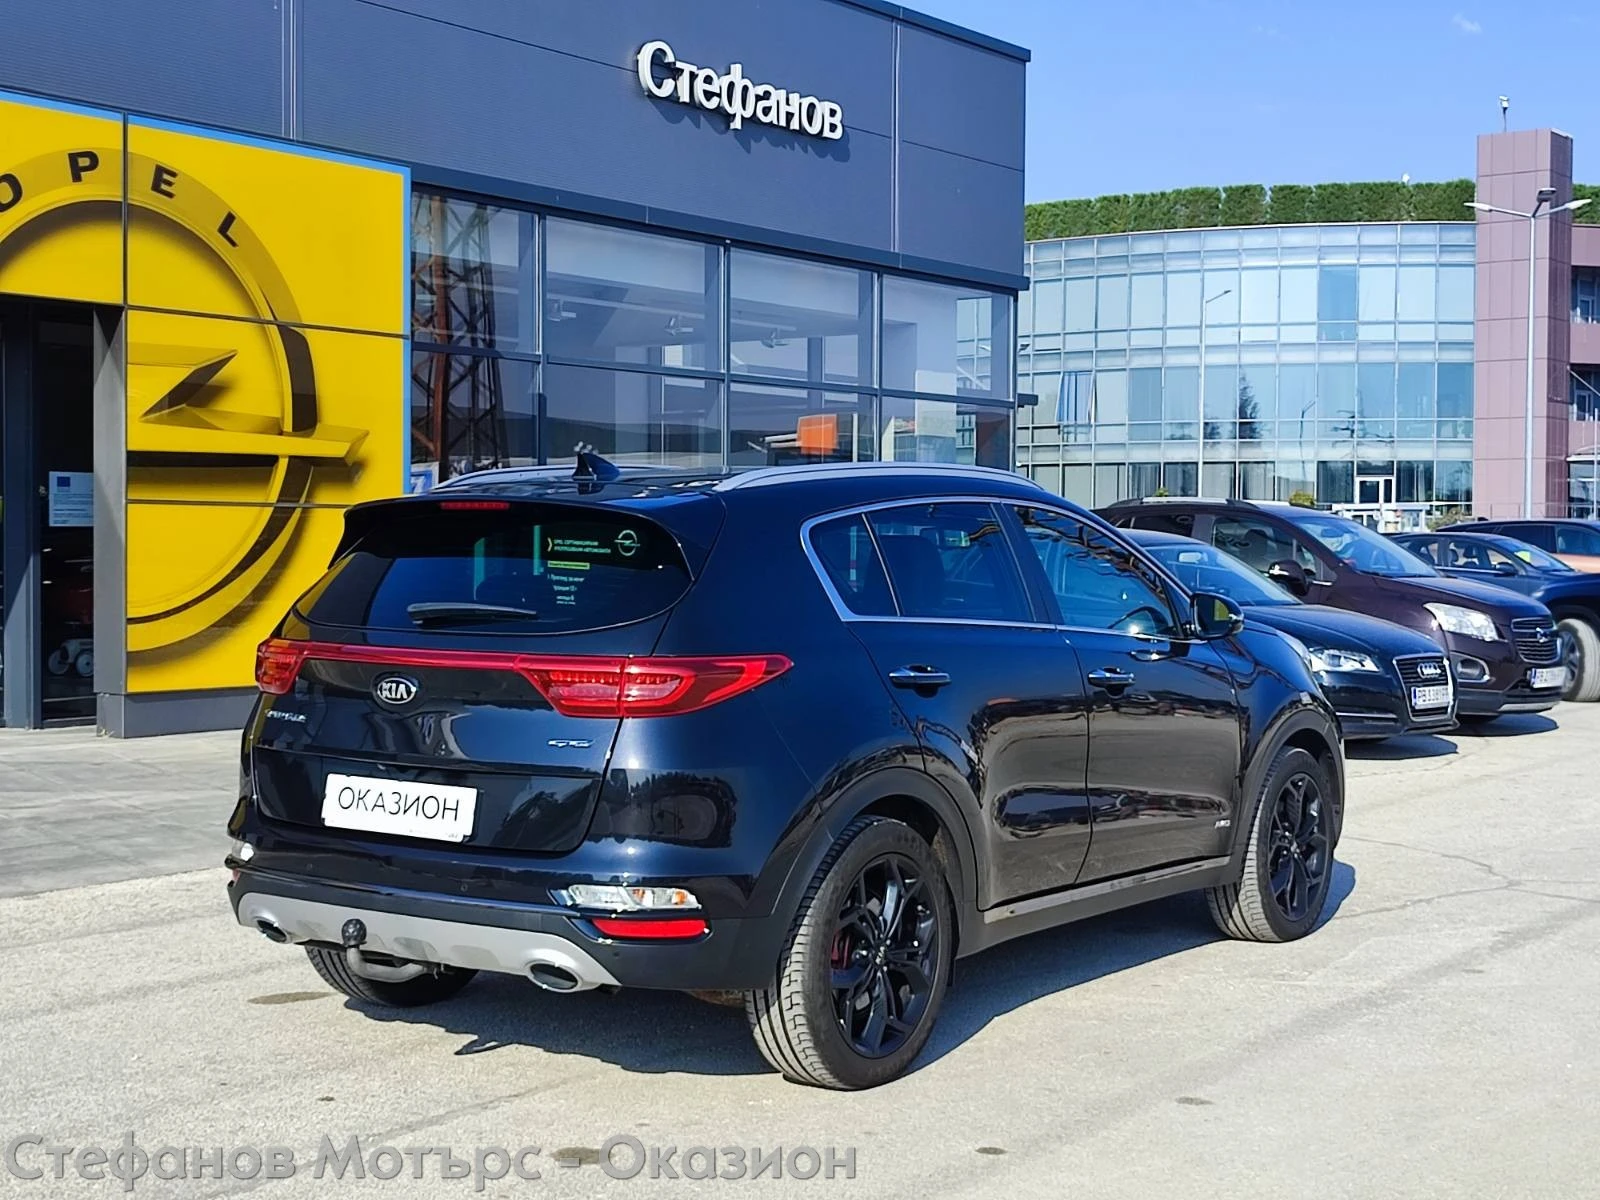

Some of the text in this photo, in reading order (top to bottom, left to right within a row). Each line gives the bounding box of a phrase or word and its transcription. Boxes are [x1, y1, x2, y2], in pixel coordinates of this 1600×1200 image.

[637, 40, 844, 140] Стефанов
[0, 150, 239, 248] OPEL
[338, 786, 460, 822] ОКАЗИОН
